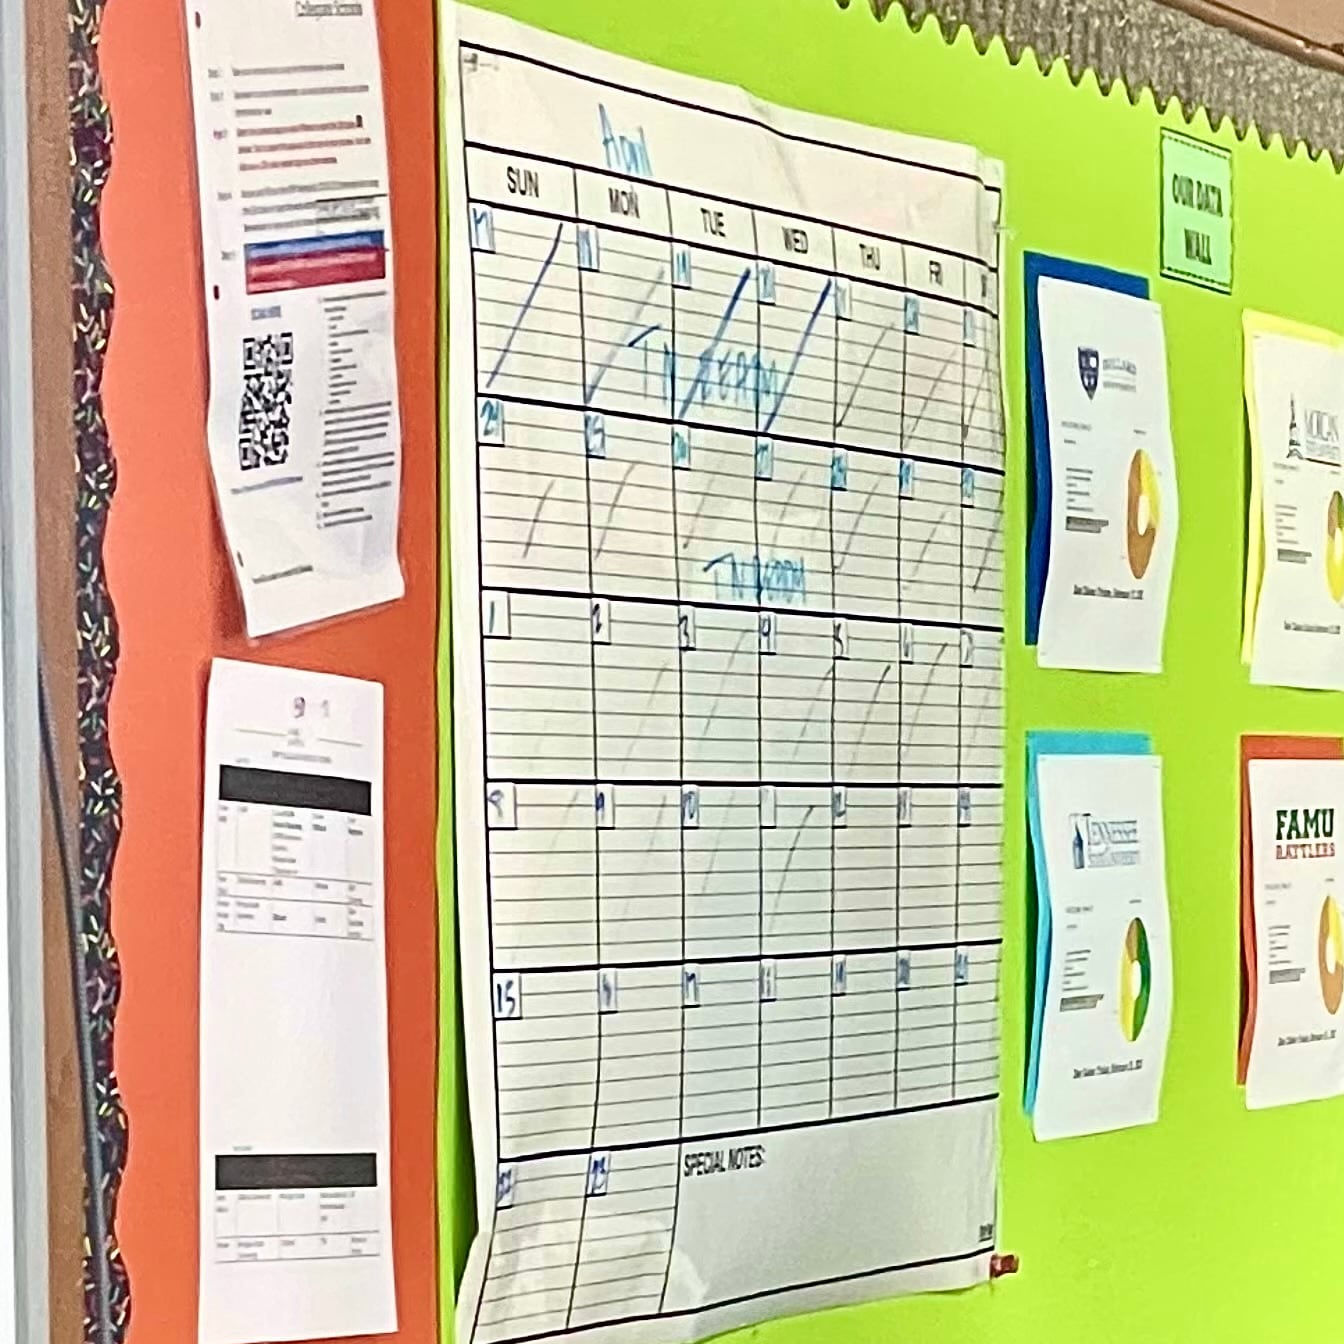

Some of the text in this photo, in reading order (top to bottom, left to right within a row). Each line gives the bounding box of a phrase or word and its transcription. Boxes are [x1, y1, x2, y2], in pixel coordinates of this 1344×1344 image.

[506, 166, 540, 199] SUN
[608, 185, 641, 219] MON
[700, 207, 727, 238] TUE
[1276, 808, 1334, 840] FAMU
[496, 978, 517, 1018] 15
[683, 1150, 726, 1177] SPECIAL
